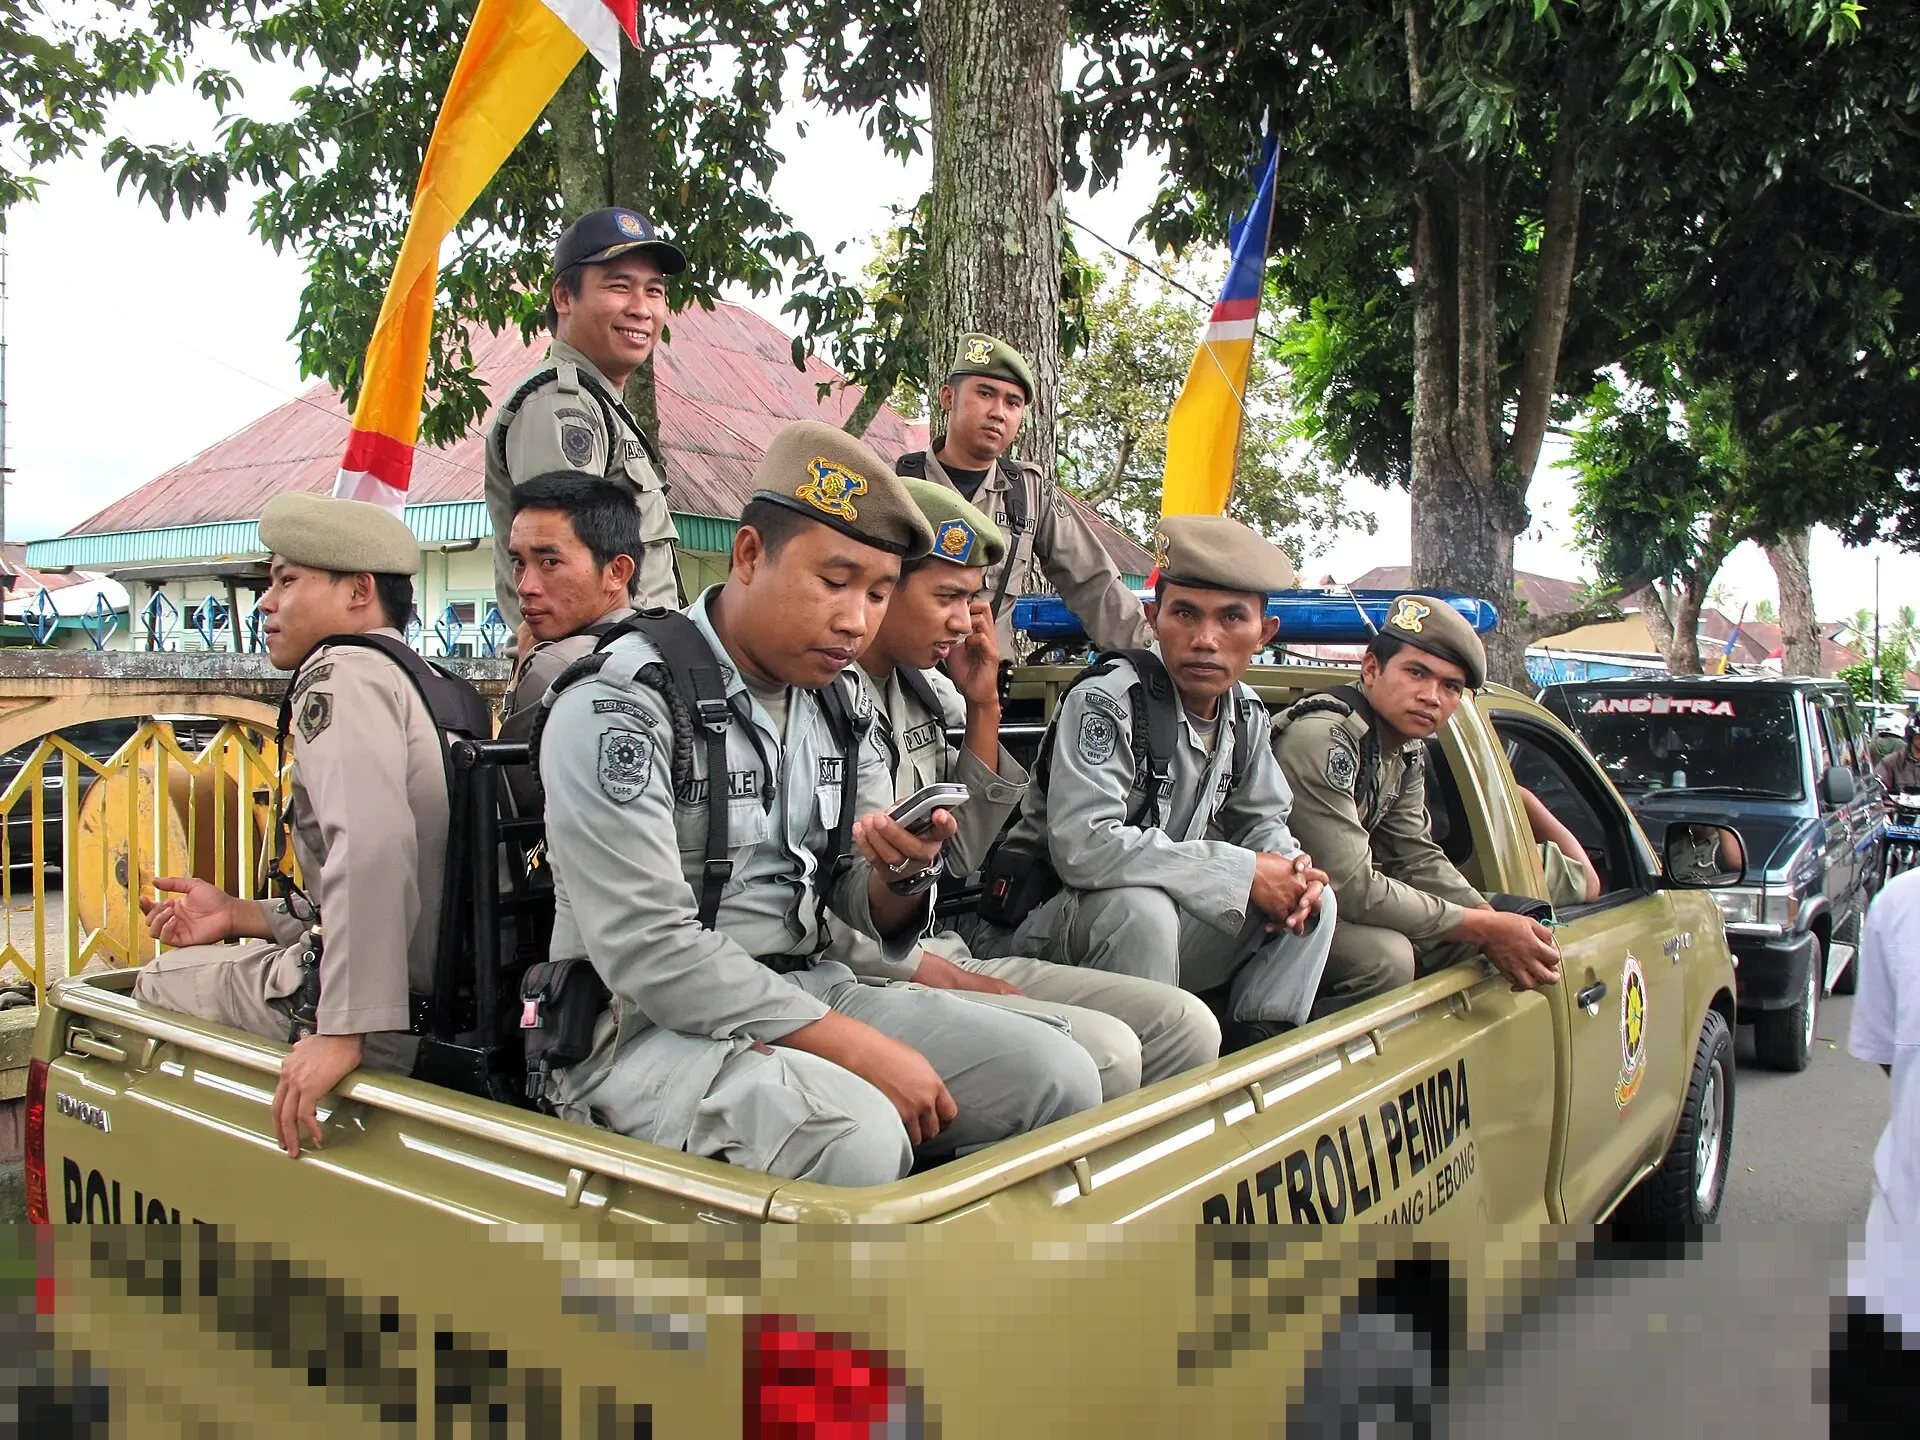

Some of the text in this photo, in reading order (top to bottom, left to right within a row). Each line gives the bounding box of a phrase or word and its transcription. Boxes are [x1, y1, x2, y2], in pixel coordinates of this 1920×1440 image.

[56, 1092, 112, 1134] TOYOTA
[1378, 1057, 1471, 1191] PEMDA
[1427, 1140, 1475, 1217] LEBONG
